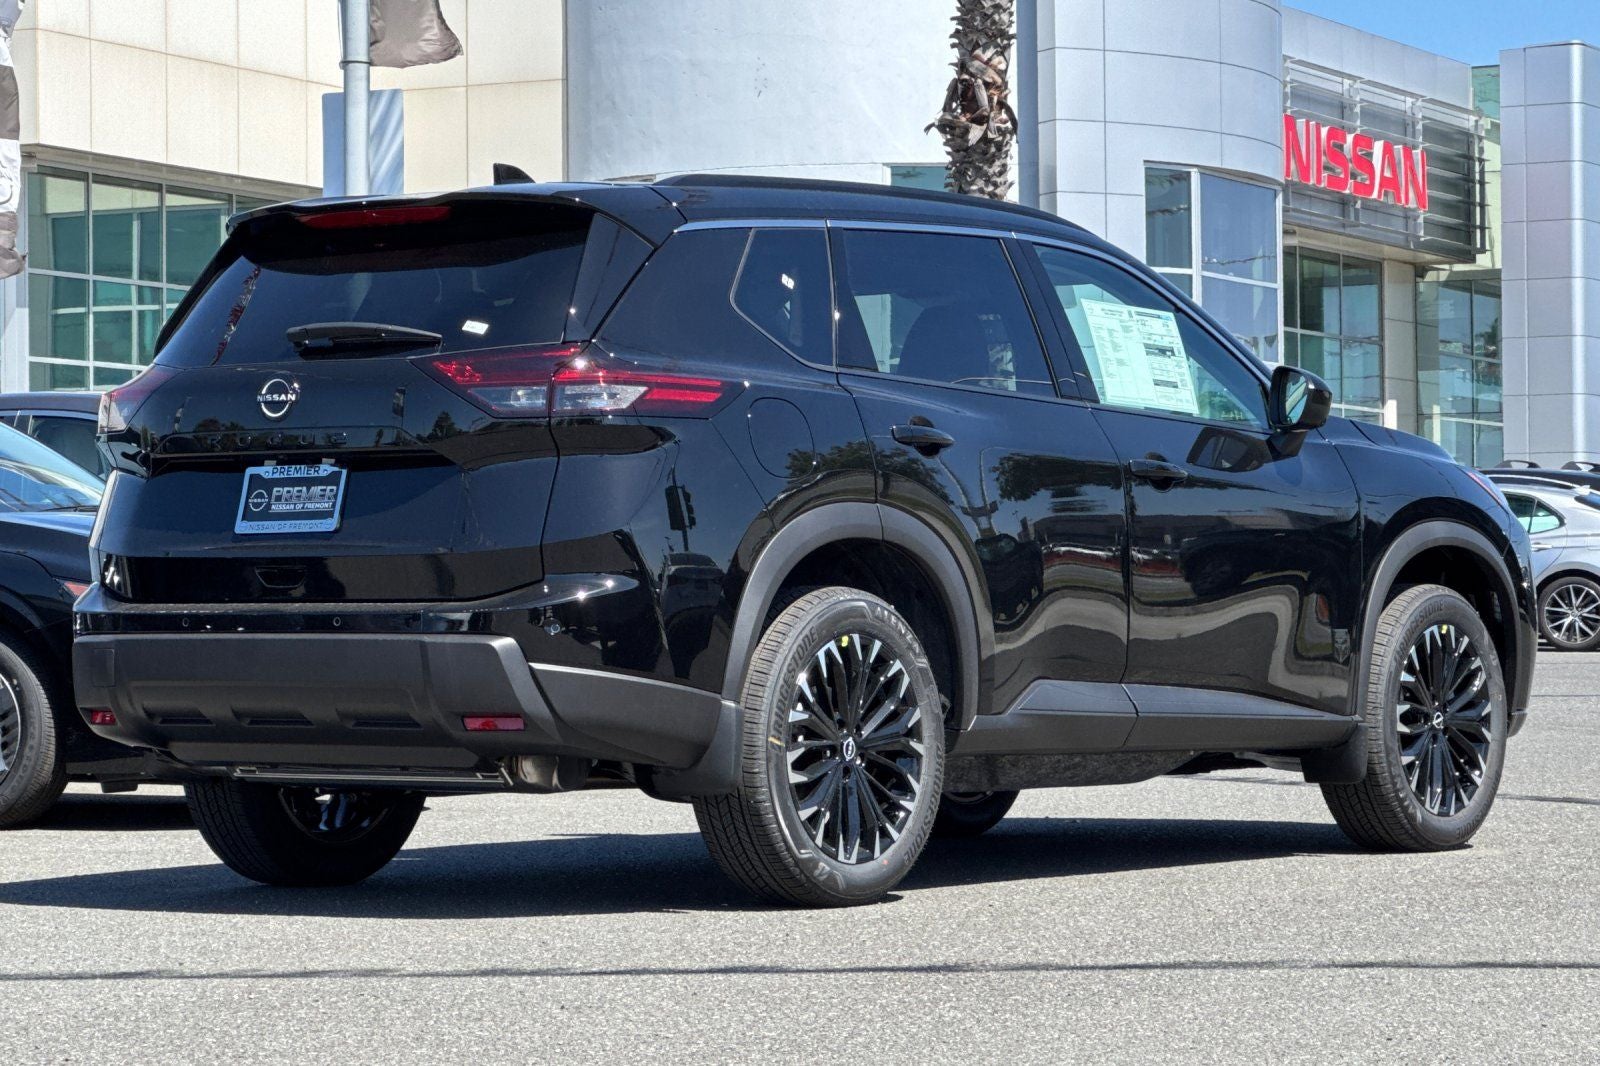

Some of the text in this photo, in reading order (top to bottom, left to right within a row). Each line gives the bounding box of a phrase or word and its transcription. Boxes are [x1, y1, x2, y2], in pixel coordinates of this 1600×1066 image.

[1283, 113, 1429, 212] NISSAN
[257, 393, 296, 403] NISSAN
[210, 430, 348, 449] ROGUE
[271, 465, 321, 477] PREMIER
[271, 485, 337, 502] PREMIER
[271, 502, 295, 510] NISSAN
[248, 523, 276, 531] NISSAN
[289, 521, 324, 530] FREMONT
